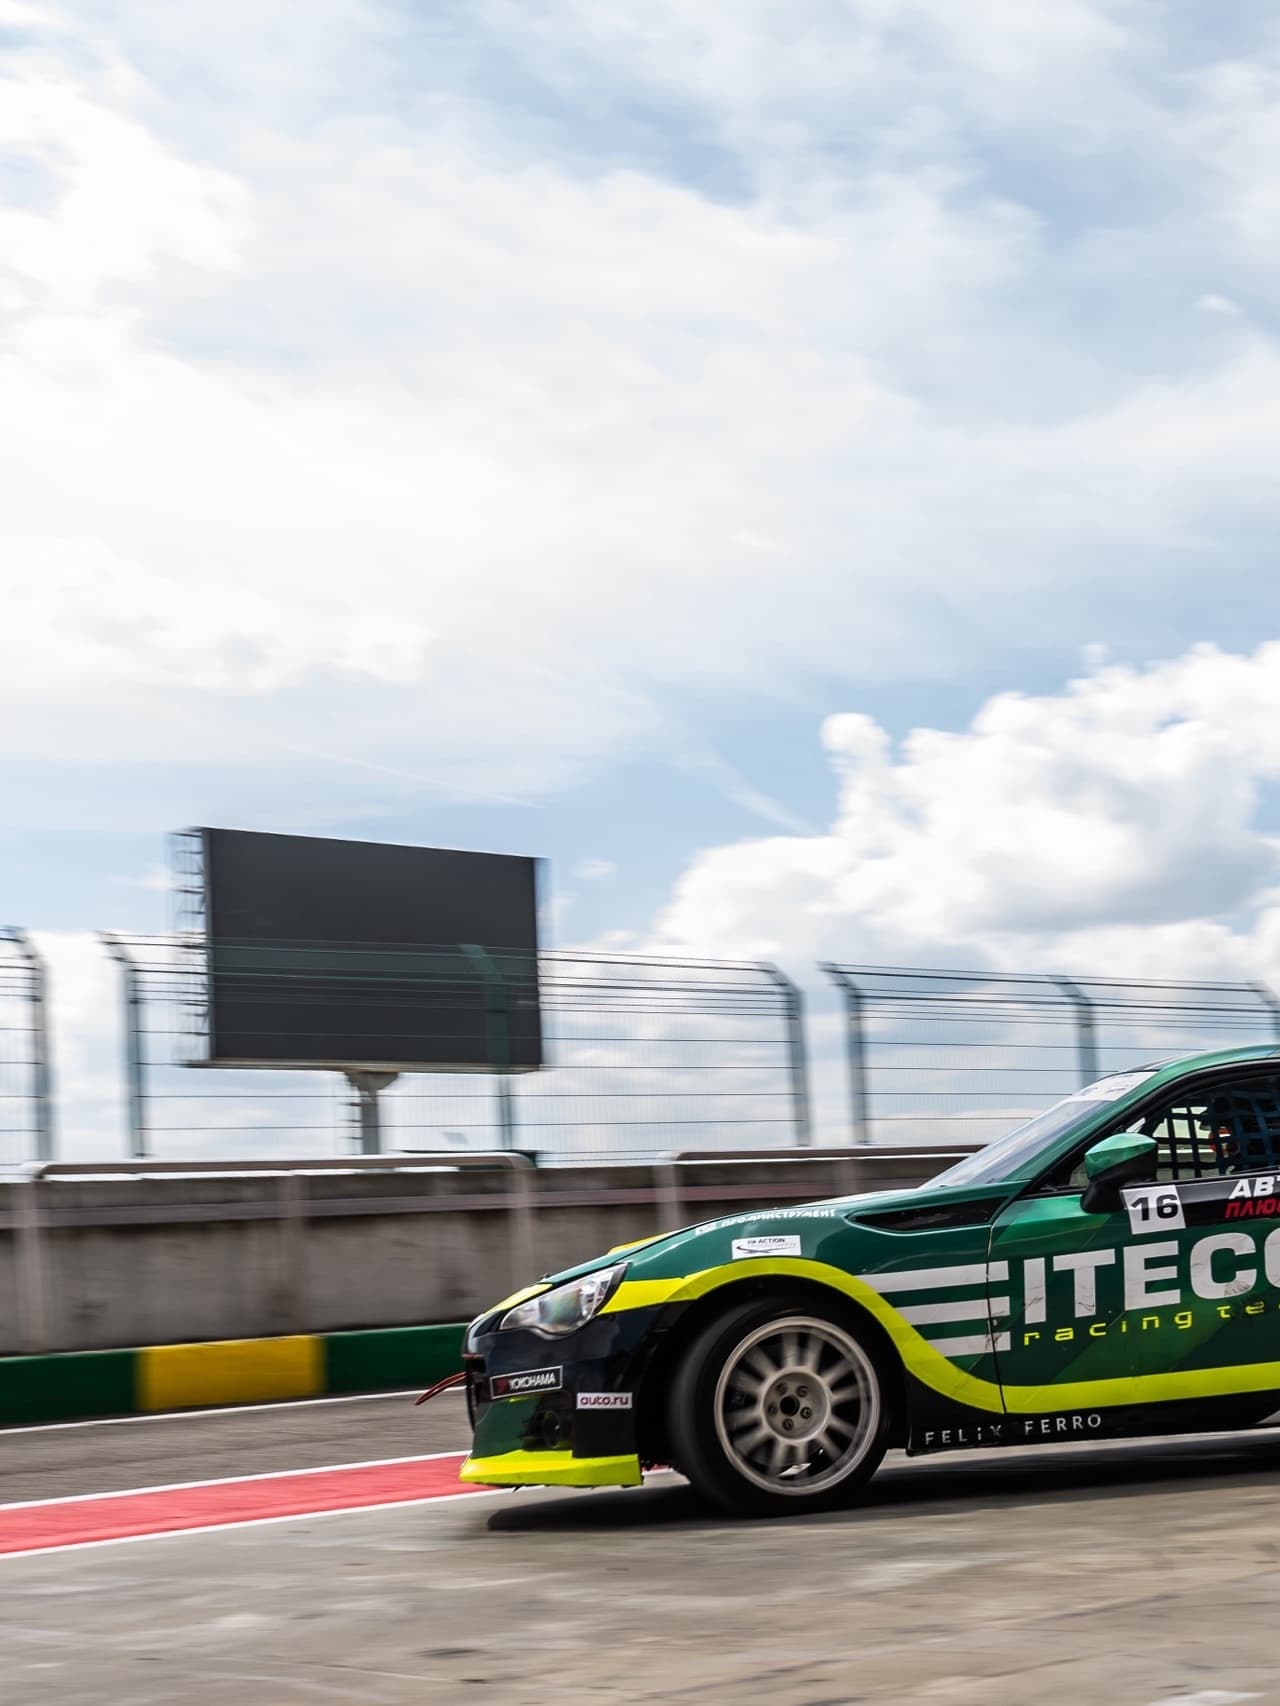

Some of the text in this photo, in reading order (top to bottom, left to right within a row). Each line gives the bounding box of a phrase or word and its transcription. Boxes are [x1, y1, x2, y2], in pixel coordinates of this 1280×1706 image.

[1129, 1193, 1180, 1222] 16
[1023, 1310, 1194, 1347] racing
[510, 1372, 556, 1390] YOKOHAMA
[579, 1394, 629, 1406] auto.ru
[1023, 1413, 1102, 1437] FERRO
